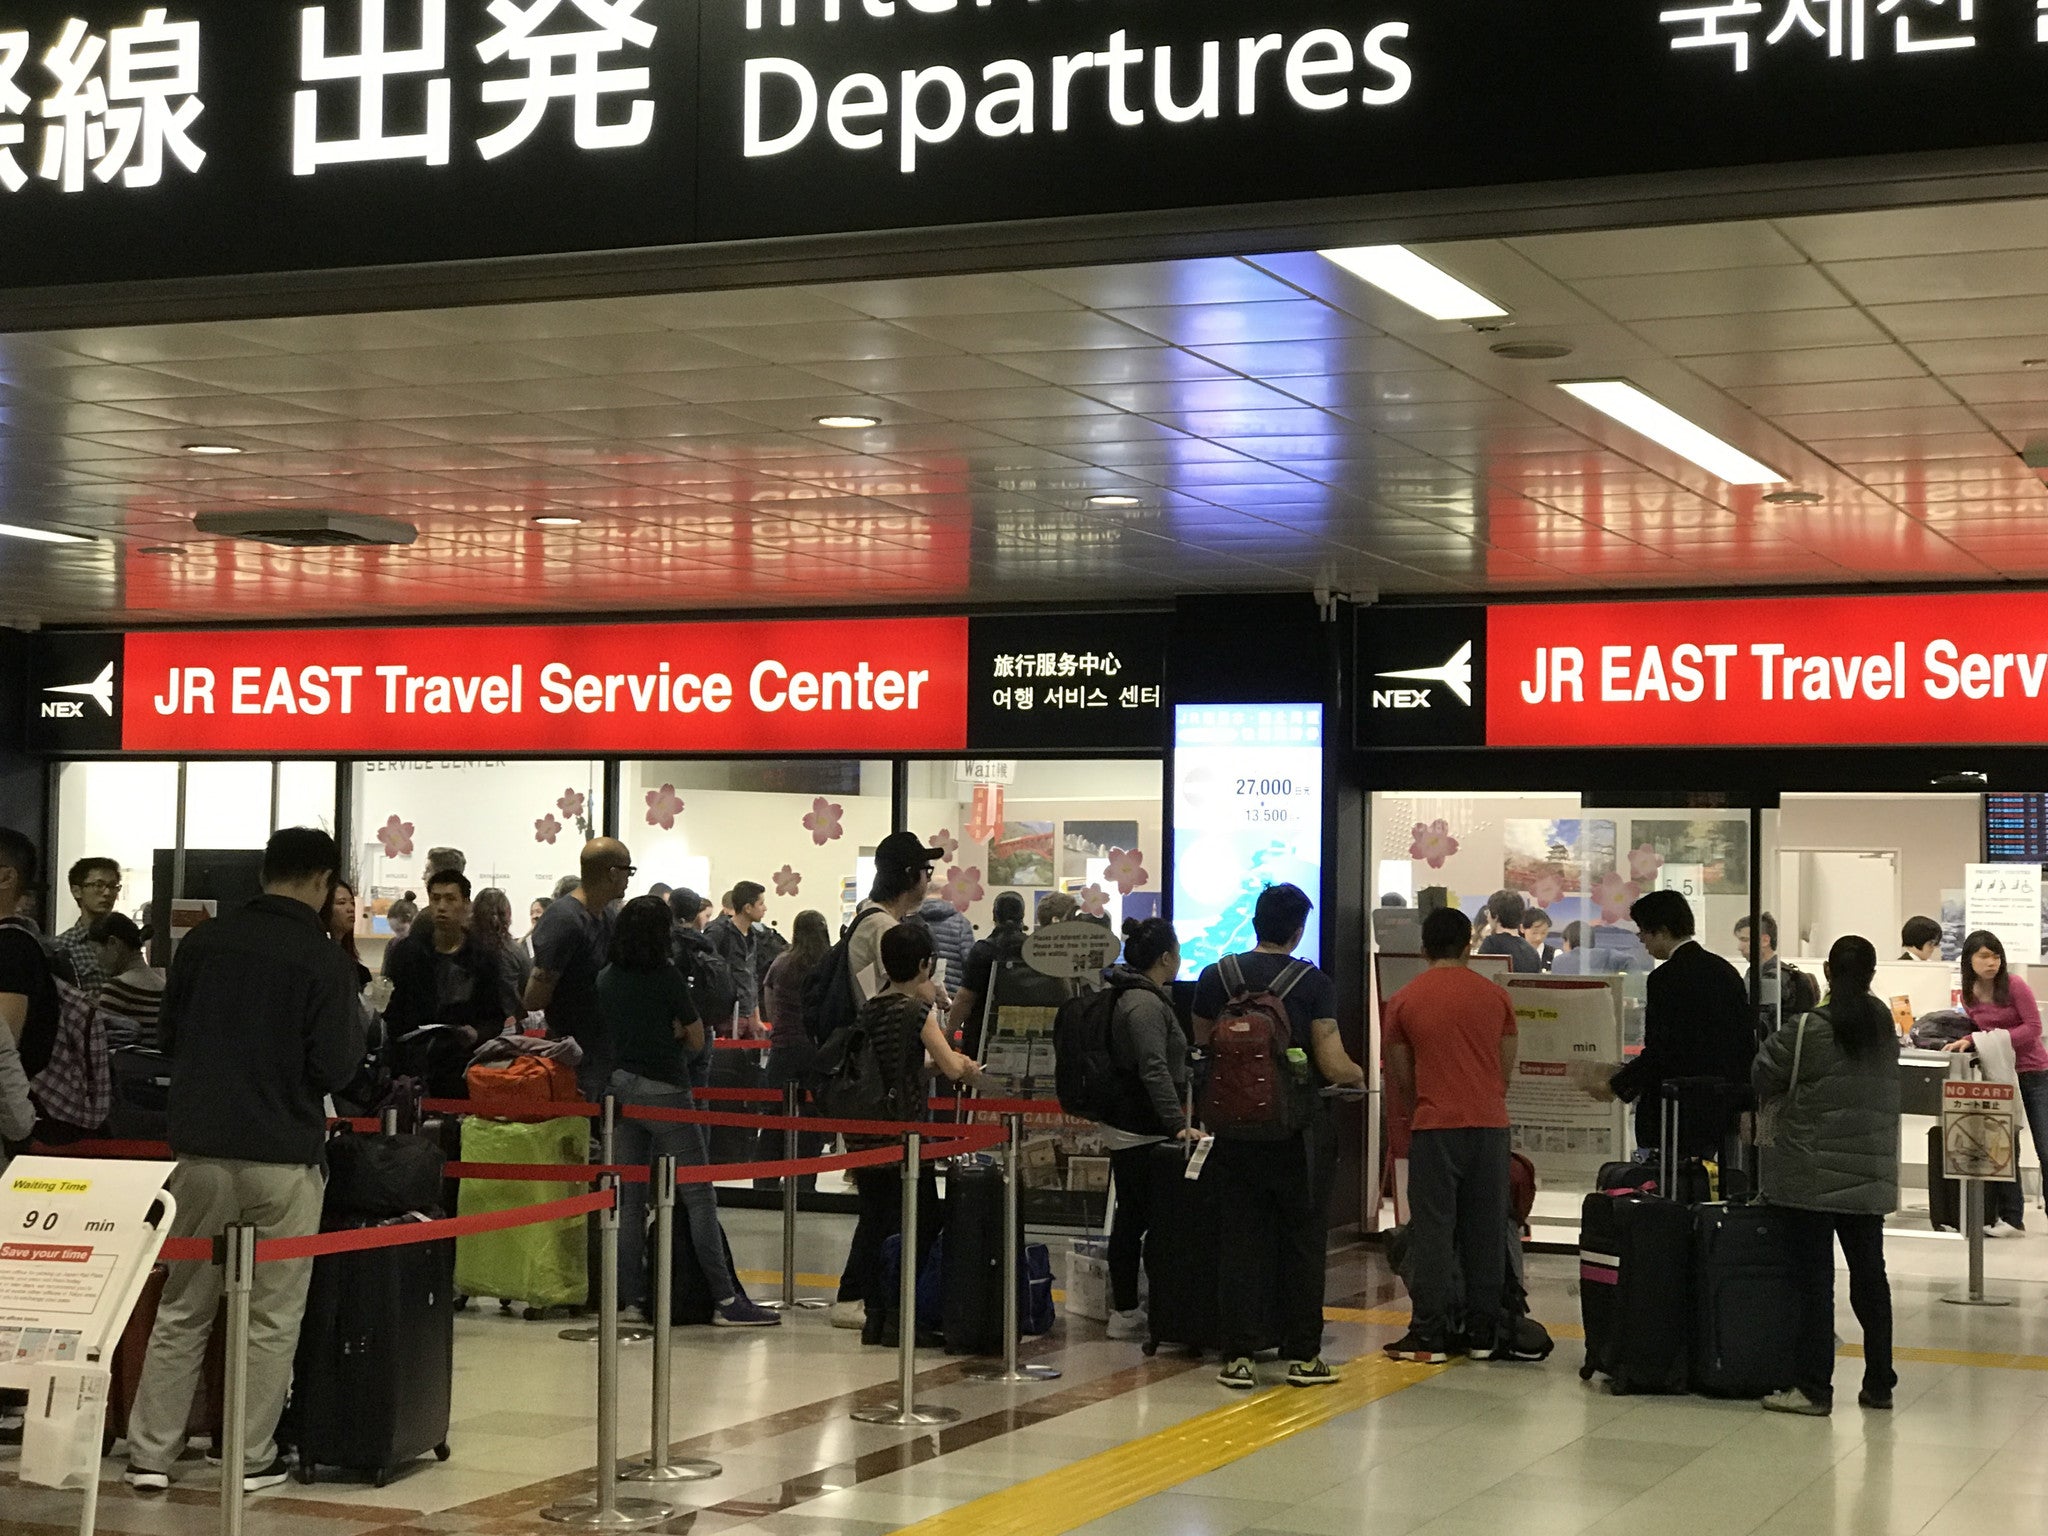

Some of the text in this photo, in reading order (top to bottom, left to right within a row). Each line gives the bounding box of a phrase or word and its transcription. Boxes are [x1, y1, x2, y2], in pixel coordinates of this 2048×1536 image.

[0, 0, 657, 193] 線 出発
[744, 22, 1412, 173] Departures
[993, 651, 1122, 677] 旅行服务中心
[1521, 646, 1584, 704] JR
[1602, 643, 1738, 703] EAST
[1751, 641, 1905, 701] Travel
[154, 659, 929, 715] JR EAST Travel Service Center
[992, 684, 1160, 710] 여행 서비스 센터
[1236, 779, 1292, 796] 27,000
[1246, 809, 1288, 822] 13500
[1573, 1042, 1596, 1052] min
[1946, 1086, 2012, 1099] NO CART
[13, 1180, 87, 1192] Waiting Time
[84, 1218, 115, 1232] min
[0, 1246, 88, 1260] Save your time
